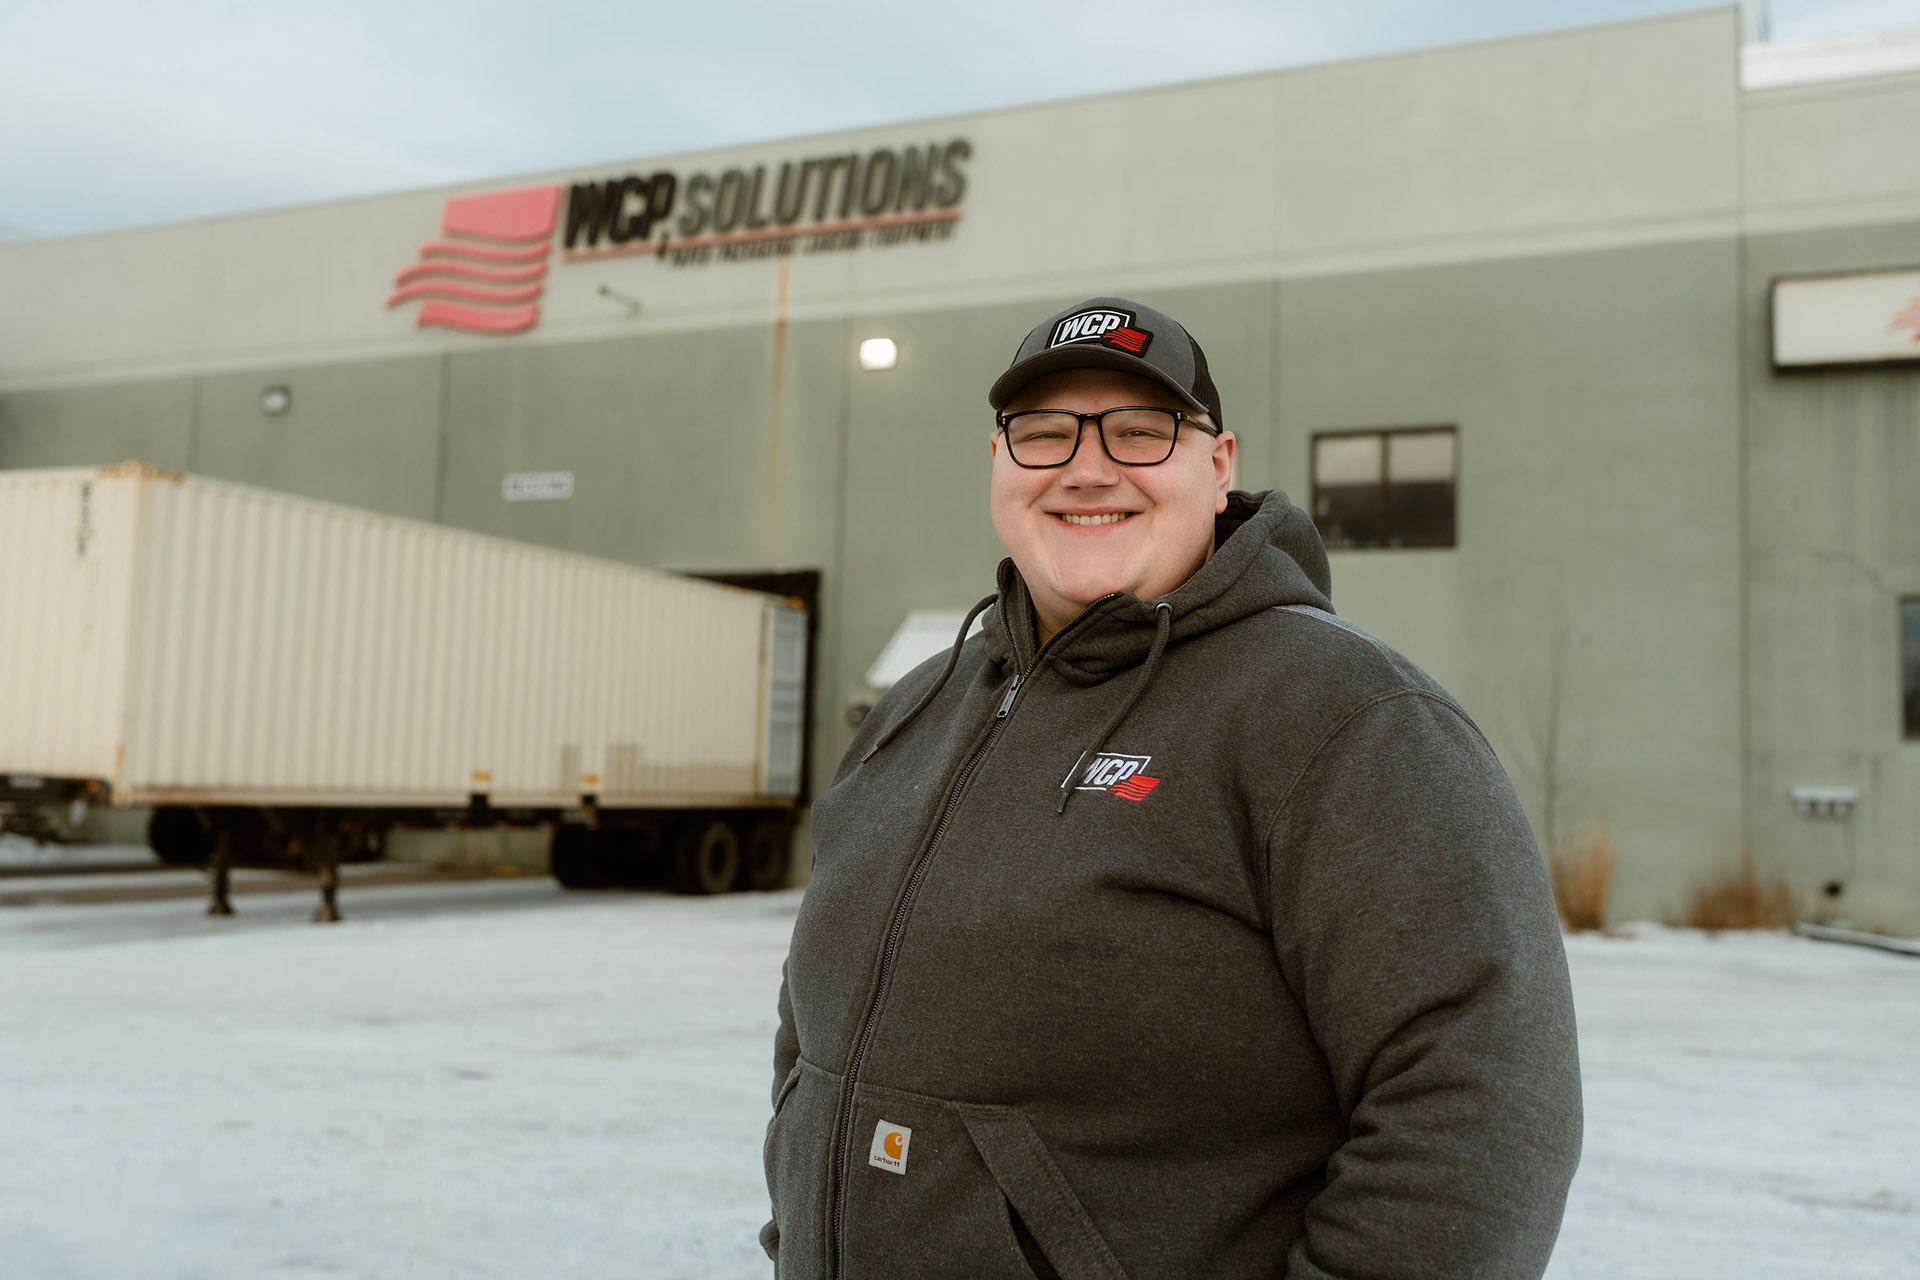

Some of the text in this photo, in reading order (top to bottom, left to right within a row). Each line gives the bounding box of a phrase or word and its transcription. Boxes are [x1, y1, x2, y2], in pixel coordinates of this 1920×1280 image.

[565, 138, 972, 248] WCP SOLUTIONS
[1059, 313, 1121, 342] WCP
[873, 1155, 900, 1167] carhartt
